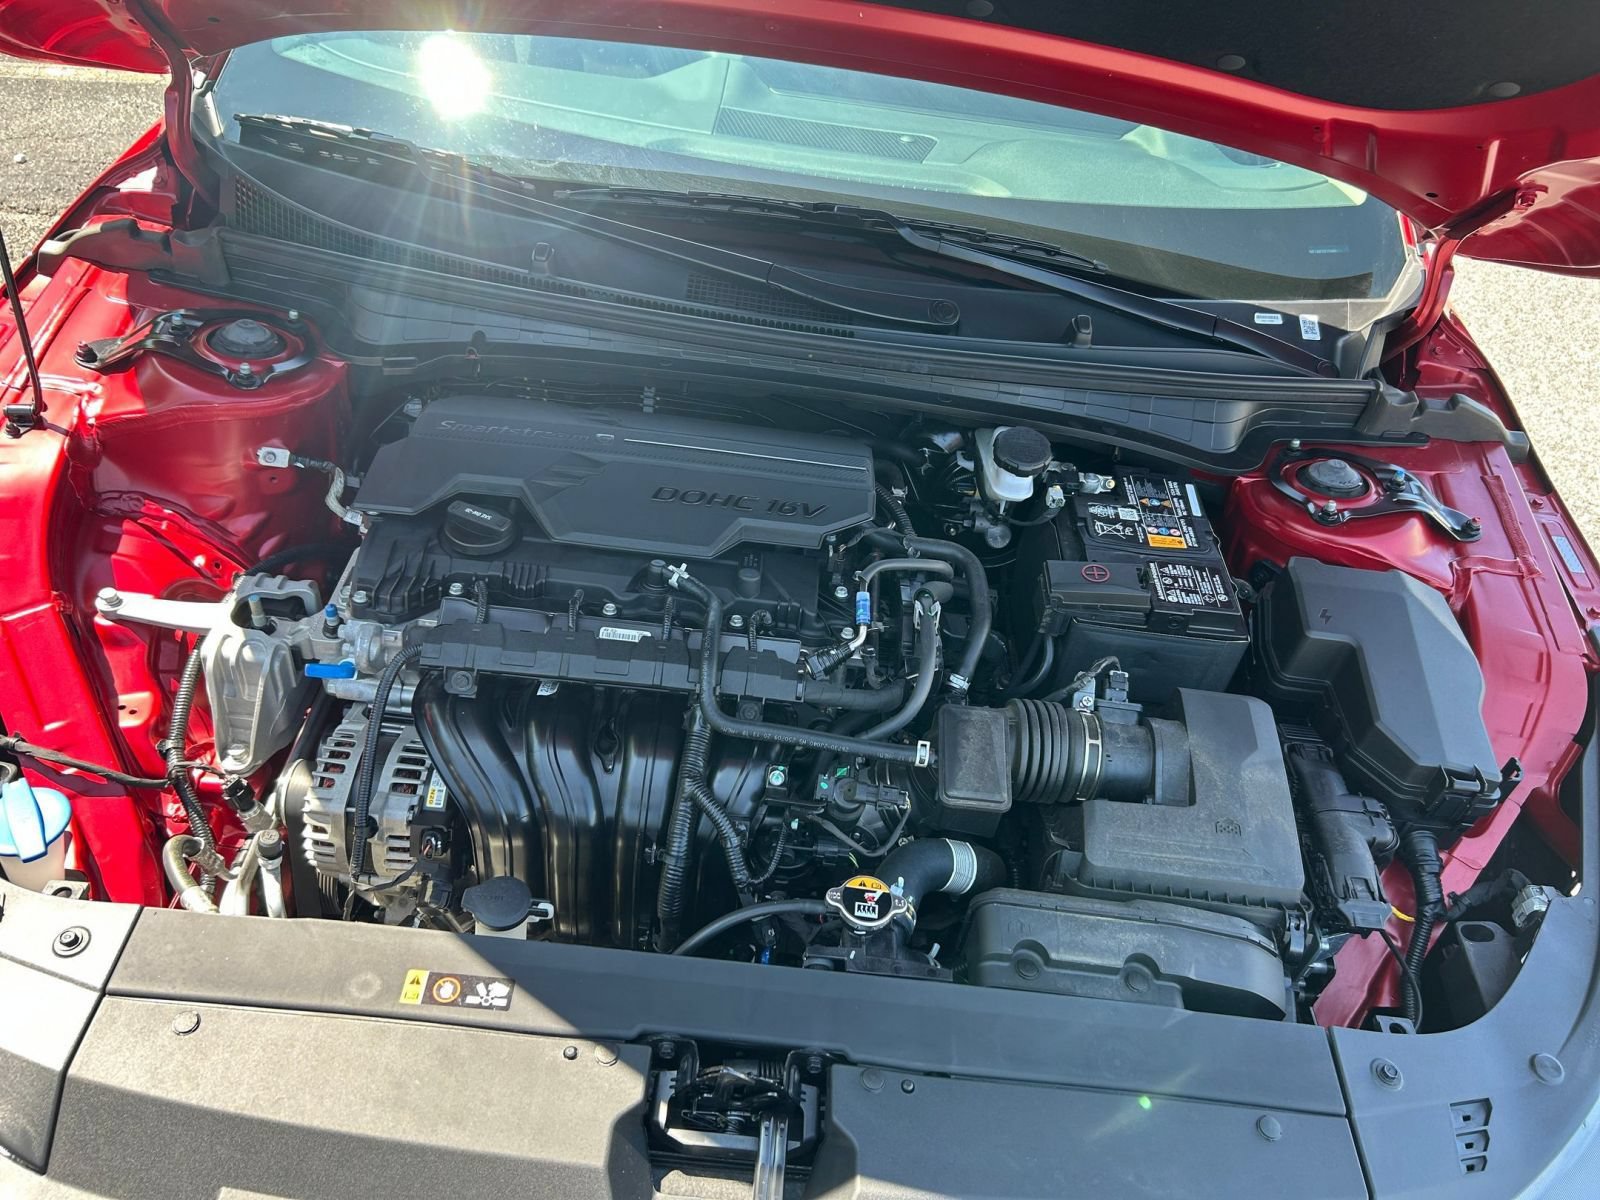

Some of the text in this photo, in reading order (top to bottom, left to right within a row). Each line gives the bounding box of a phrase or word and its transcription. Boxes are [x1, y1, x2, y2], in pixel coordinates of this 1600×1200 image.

[437, 420, 590, 442] Smartstream
[651, 486, 830, 518] DOHC 16V
